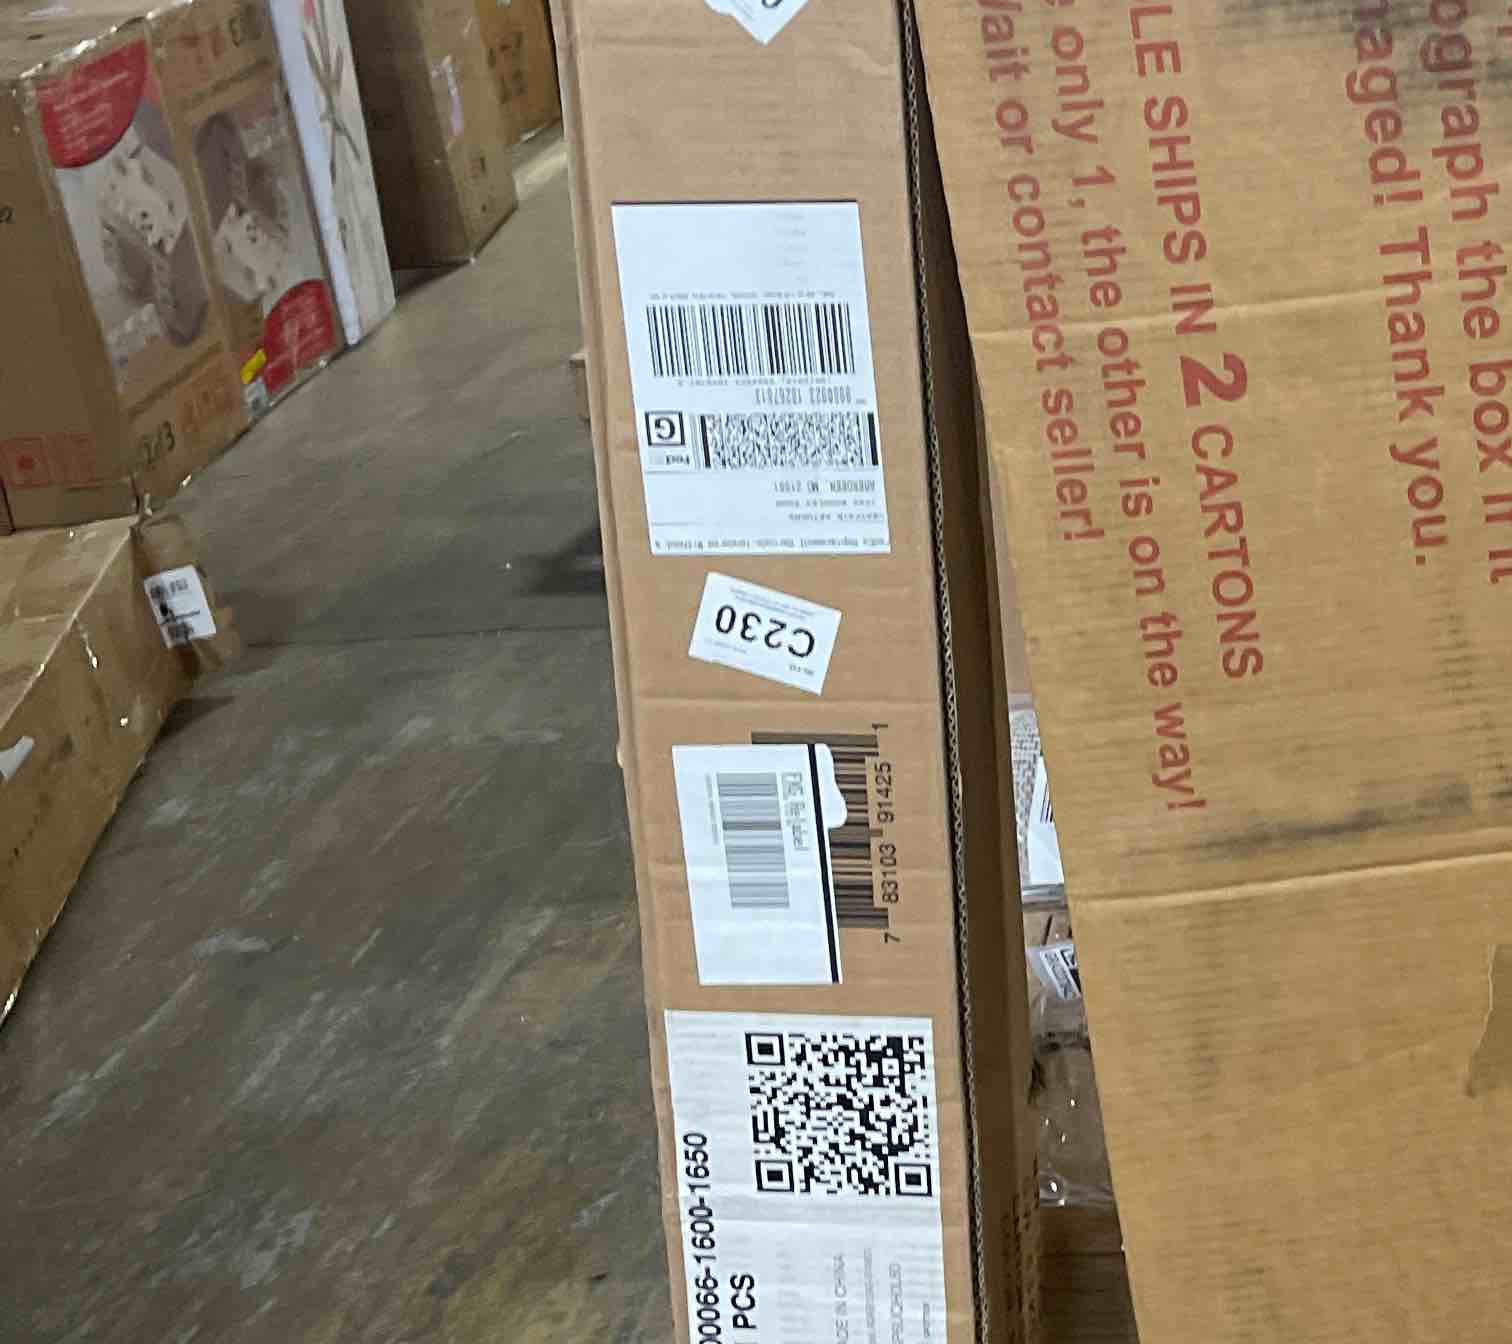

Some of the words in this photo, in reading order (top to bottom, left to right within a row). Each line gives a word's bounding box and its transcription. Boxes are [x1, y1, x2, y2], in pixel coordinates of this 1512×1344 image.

[1050, 26, 1105, 144] only
[994, 99, 1037, 154] or
[1070, 165, 1116, 209] 1,
[1143, 96, 1208, 265] SHIPS
[1007, 174, 1075, 372] contact
[1080, 226, 1126, 308] the
[1454, 240, 1507, 340] the
[1169, 283, 1216, 335] IN
[1378, 225, 1445, 422] Thank
[1097, 327, 1147, 460] other
[1179, 352, 1249, 408] 2
[655, 417, 676, 441] G
[1038, 389, 1105, 542] seller!
[1118, 476, 1161, 519] is
[1389, 436, 1449, 566] you.
[1128, 535, 1167, 597] on
[1190, 422, 1263, 680] CARTONS
[715, 605, 815, 658] C230
[1140, 611, 1182, 687] the
[1151, 702, 1207, 812] way!
[875, 762, 894, 823] 91425
[880, 844, 899, 904] 83103
[883, 932, 900, 944] 7
[731, 1274, 756, 1329] PCS
